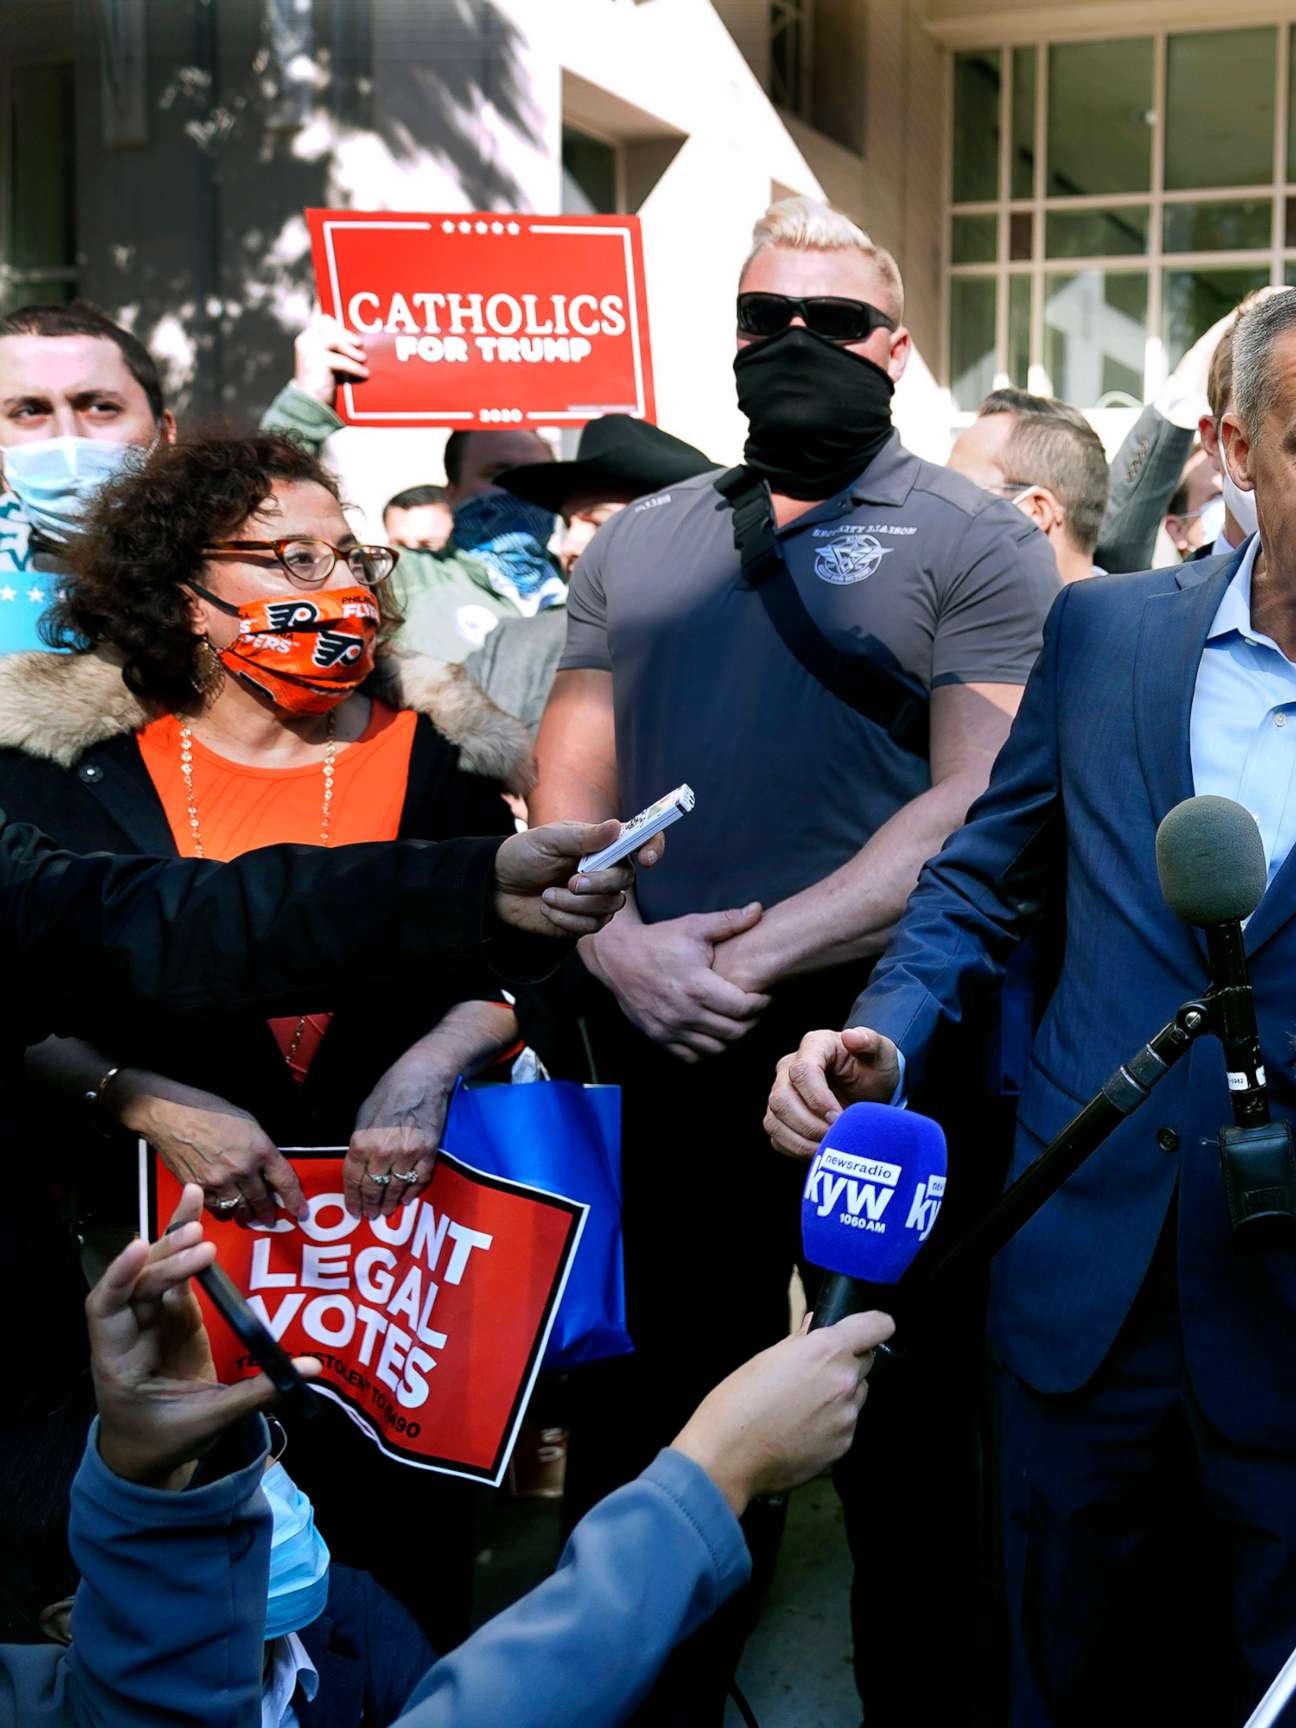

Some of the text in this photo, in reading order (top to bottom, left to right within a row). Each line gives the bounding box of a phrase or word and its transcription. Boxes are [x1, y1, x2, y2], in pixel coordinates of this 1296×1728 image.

[348, 291, 626, 337] CATHOLICS
[394, 336, 592, 363] FOR TRUMP
[804, 1154, 895, 1222] kyw
[825, 1154, 892, 1180] newsradio
[905, 1182, 942, 1242] ky
[249, 1237, 448, 1350] LEGAL
[246, 1293, 437, 1409] VOTES
